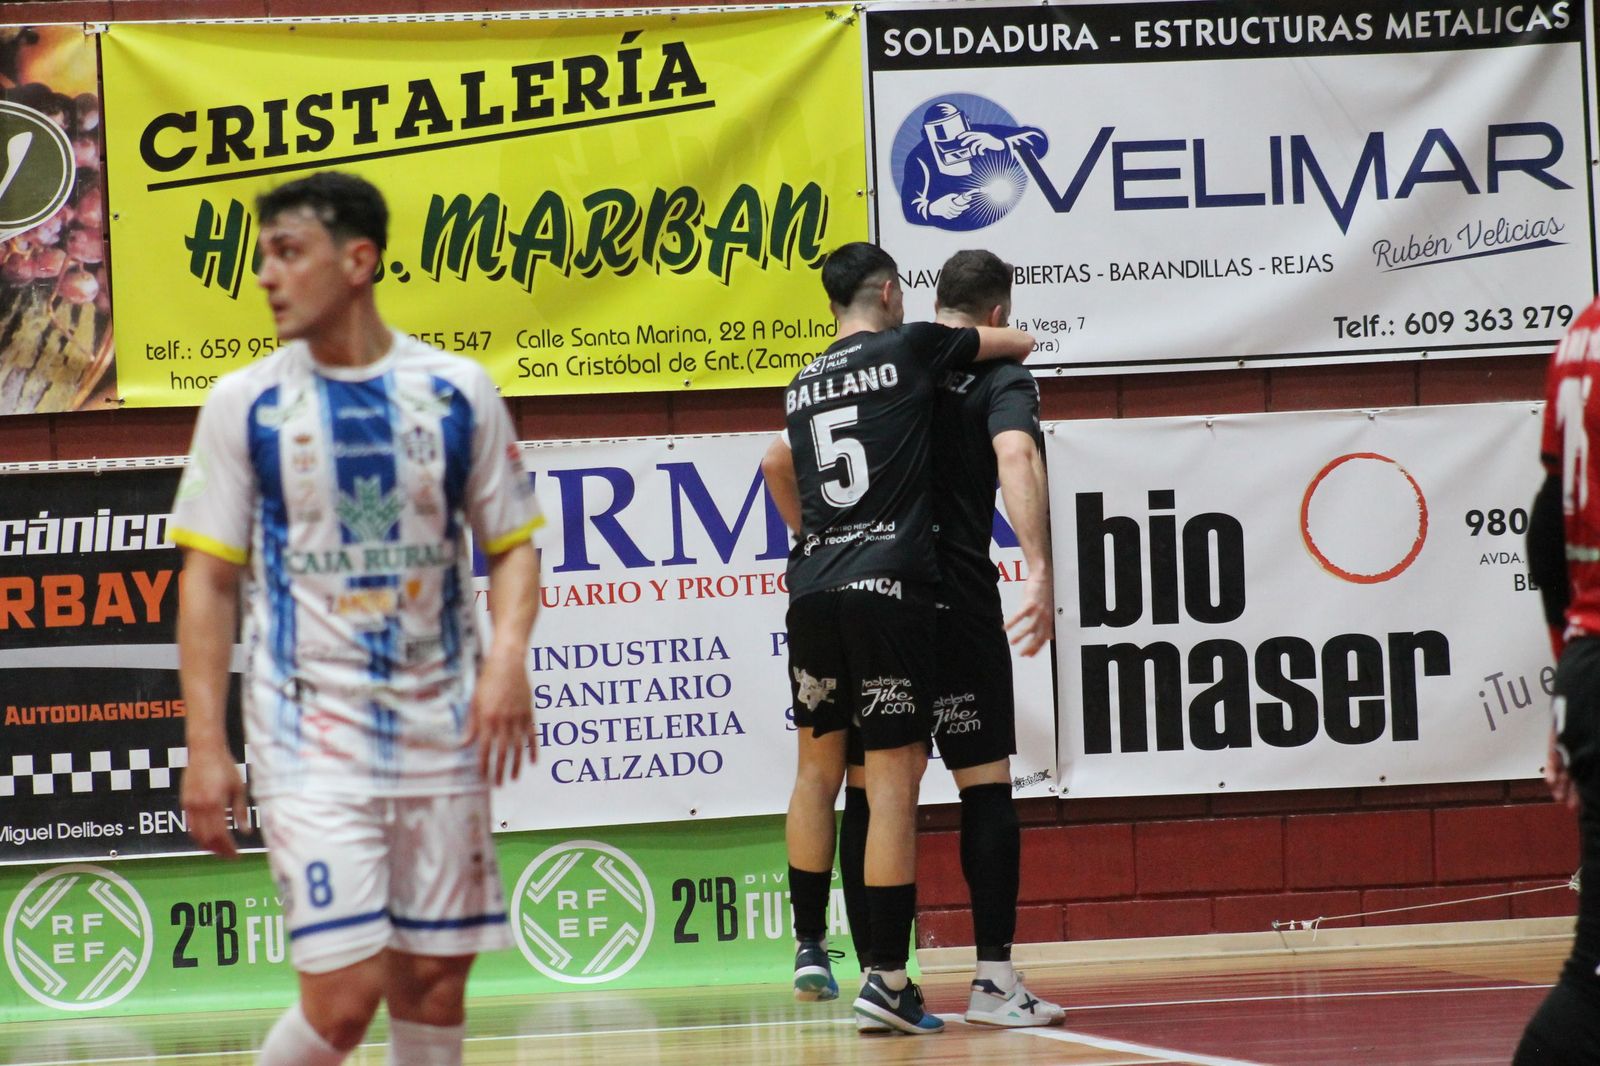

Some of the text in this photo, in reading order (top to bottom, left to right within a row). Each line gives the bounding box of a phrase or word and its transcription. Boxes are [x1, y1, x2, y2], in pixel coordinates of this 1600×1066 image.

[883, 23, 1099, 57] SOLDADURA
[1135, 14, 1373, 49] ESTRUCTURAS
[1385, 1, 1569, 40] METALICAS
[139, 29, 707, 173] CRISTALERÍA
[1014, 120, 1574, 236] VELIMAR
[420, 181, 828, 294] MARBAN
[1372, 217, 1566, 268] Rubén Velicias
[1014, 264, 1091, 285] BIERTAS
[1109, 257, 1253, 283] BARANDILLAS
[1270, 254, 1335, 276] REJAS
[516, 329, 565, 349] Calle
[571, 327, 631, 347] Santa
[636, 324, 712, 345] Marina,
[719, 321, 746, 341] 22
[752, 320, 766, 340] A
[1031, 317, 1072, 335] Vega,
[1077, 316, 1086, 329] 7
[1333, 304, 1574, 339] Telf.: 609 363 279
[145, 340, 192, 361] telf.:
[200, 338, 241, 359] 659
[453, 331, 492, 351] 547
[826, 356, 848, 370] PLUS
[828, 343, 863, 361] KITCHEN
[518, 357, 559, 378] San
[566, 352, 662, 376] Cristóbal
[668, 351, 698, 373] de
[786, 362, 898, 416] BALLANO
[809, 405, 870, 508] 5
[1465, 507, 1529, 538] 980
[1074, 488, 1247, 629] bio
[1479, 551, 1525, 566] AVDA.
[648, 580, 669, 602] Y
[531, 636, 731, 672] INDUSTRIA
[534, 673, 732, 709] SANITARIO
[1079, 629, 1452, 756] maser
[1479, 671, 1533, 731] ¡Tu
[5, 700, 187, 726] AUTODIAGNOSIS
[880, 702, 916, 715] .com
[526, 711, 746, 748] HOSTELERIA
[945, 719, 981, 735] .com
[551, 750, 724, 784] CALZADO
[57, 822, 123, 841] Delibes
[306, 861, 334, 908] 8
